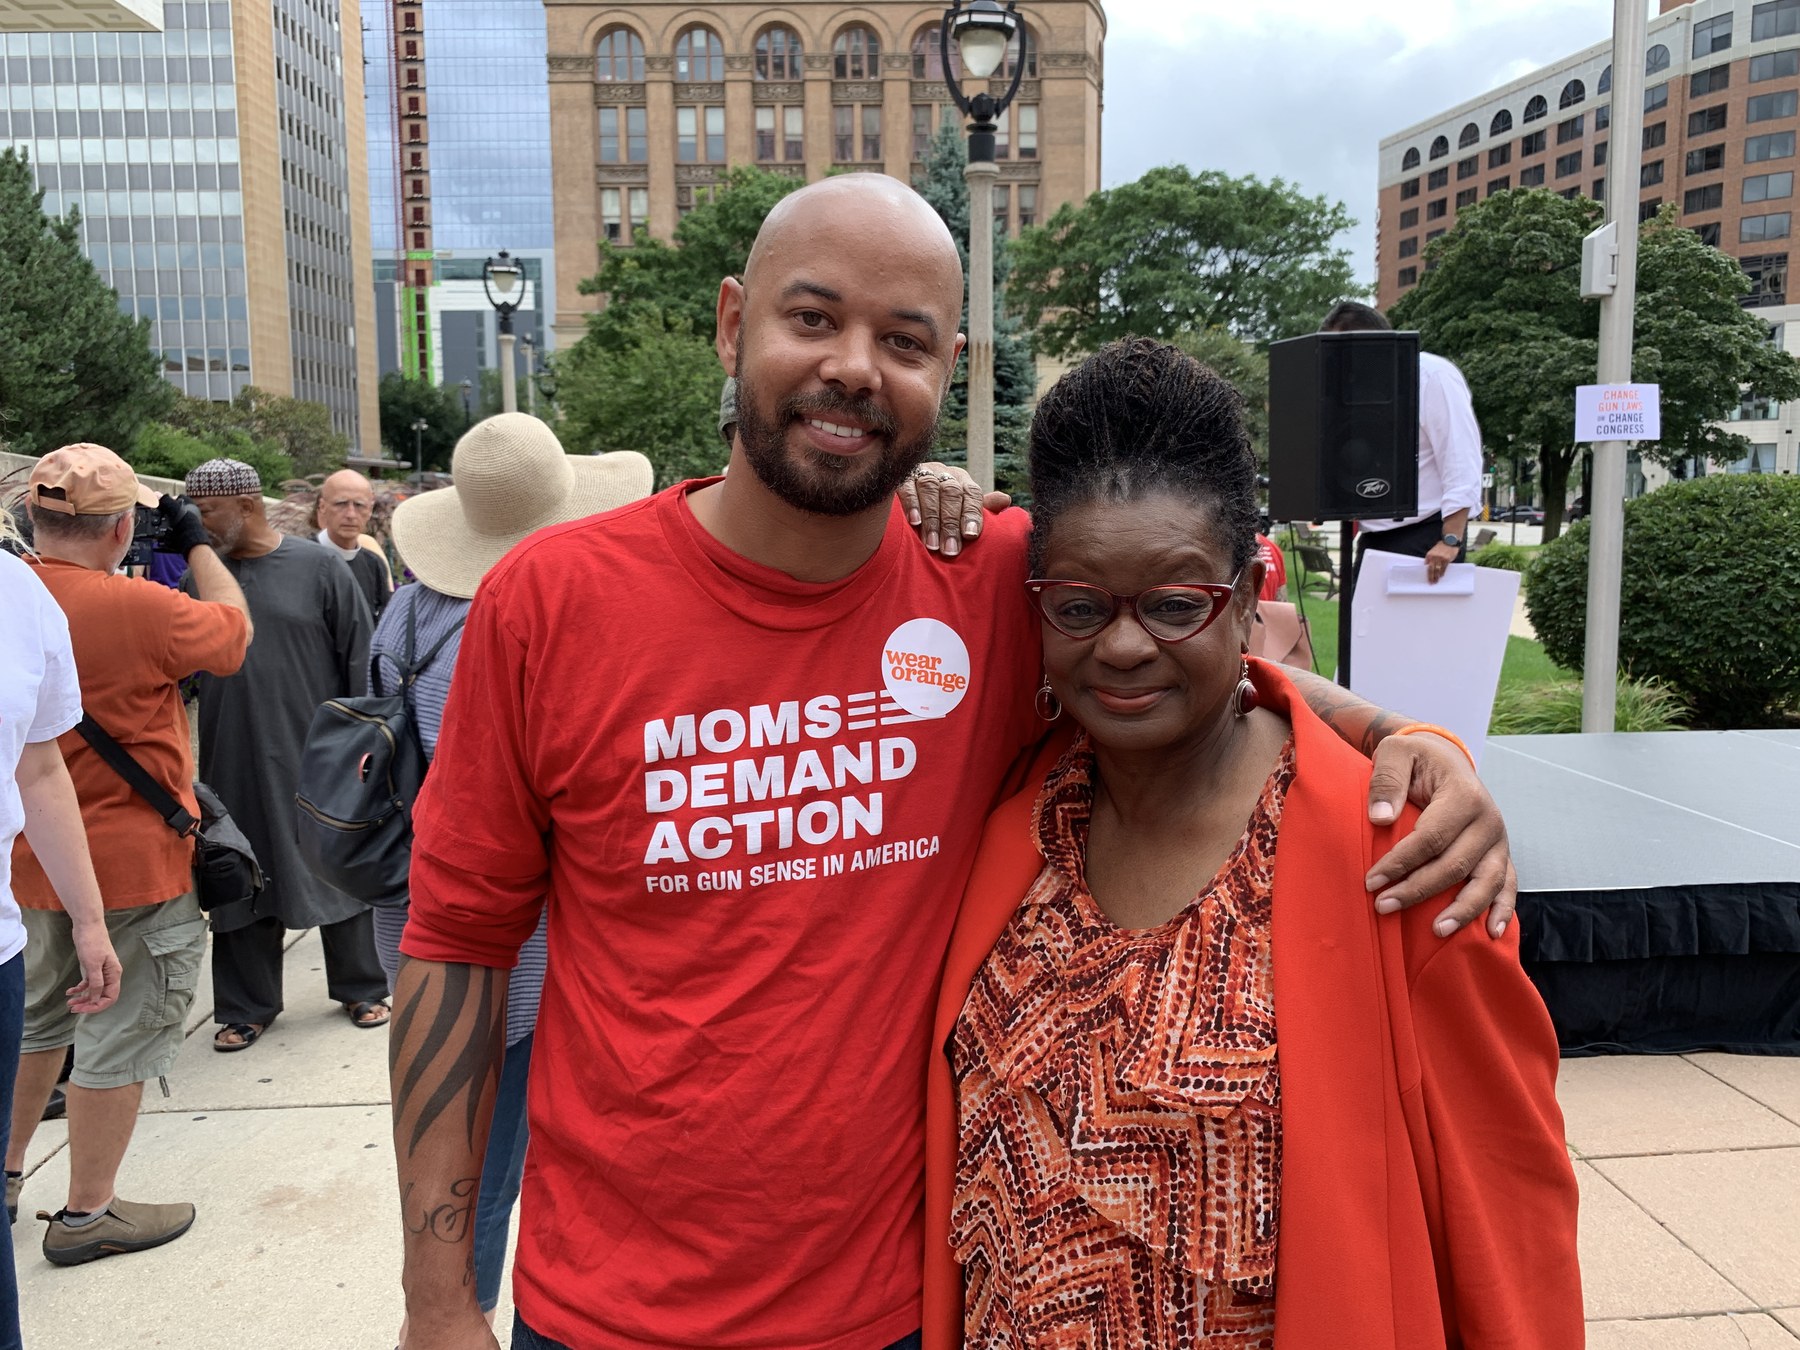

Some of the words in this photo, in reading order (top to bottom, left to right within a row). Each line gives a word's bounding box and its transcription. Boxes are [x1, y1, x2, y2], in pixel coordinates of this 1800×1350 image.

[1598, 402, 1619, 412] GUN
[1621, 401, 1644, 412] LAWS
[1603, 390, 1639, 401] CHANGE
[1596, 424, 1645, 435] CONGRESS
[1608, 413, 1644, 423] CHANGE
[885, 650, 942, 671] wear
[891, 666, 966, 693] orange
[644, 695, 842, 764] MOMS
[645, 737, 917, 813] DEMAND
[643, 792, 883, 865] ACTION
[646, 874, 690, 893] FOR
[697, 869, 742, 891] GUN
[749, 857, 817, 887] SENSE
[823, 853, 844, 877] IN
[850, 835, 940, 872] AMERICA
